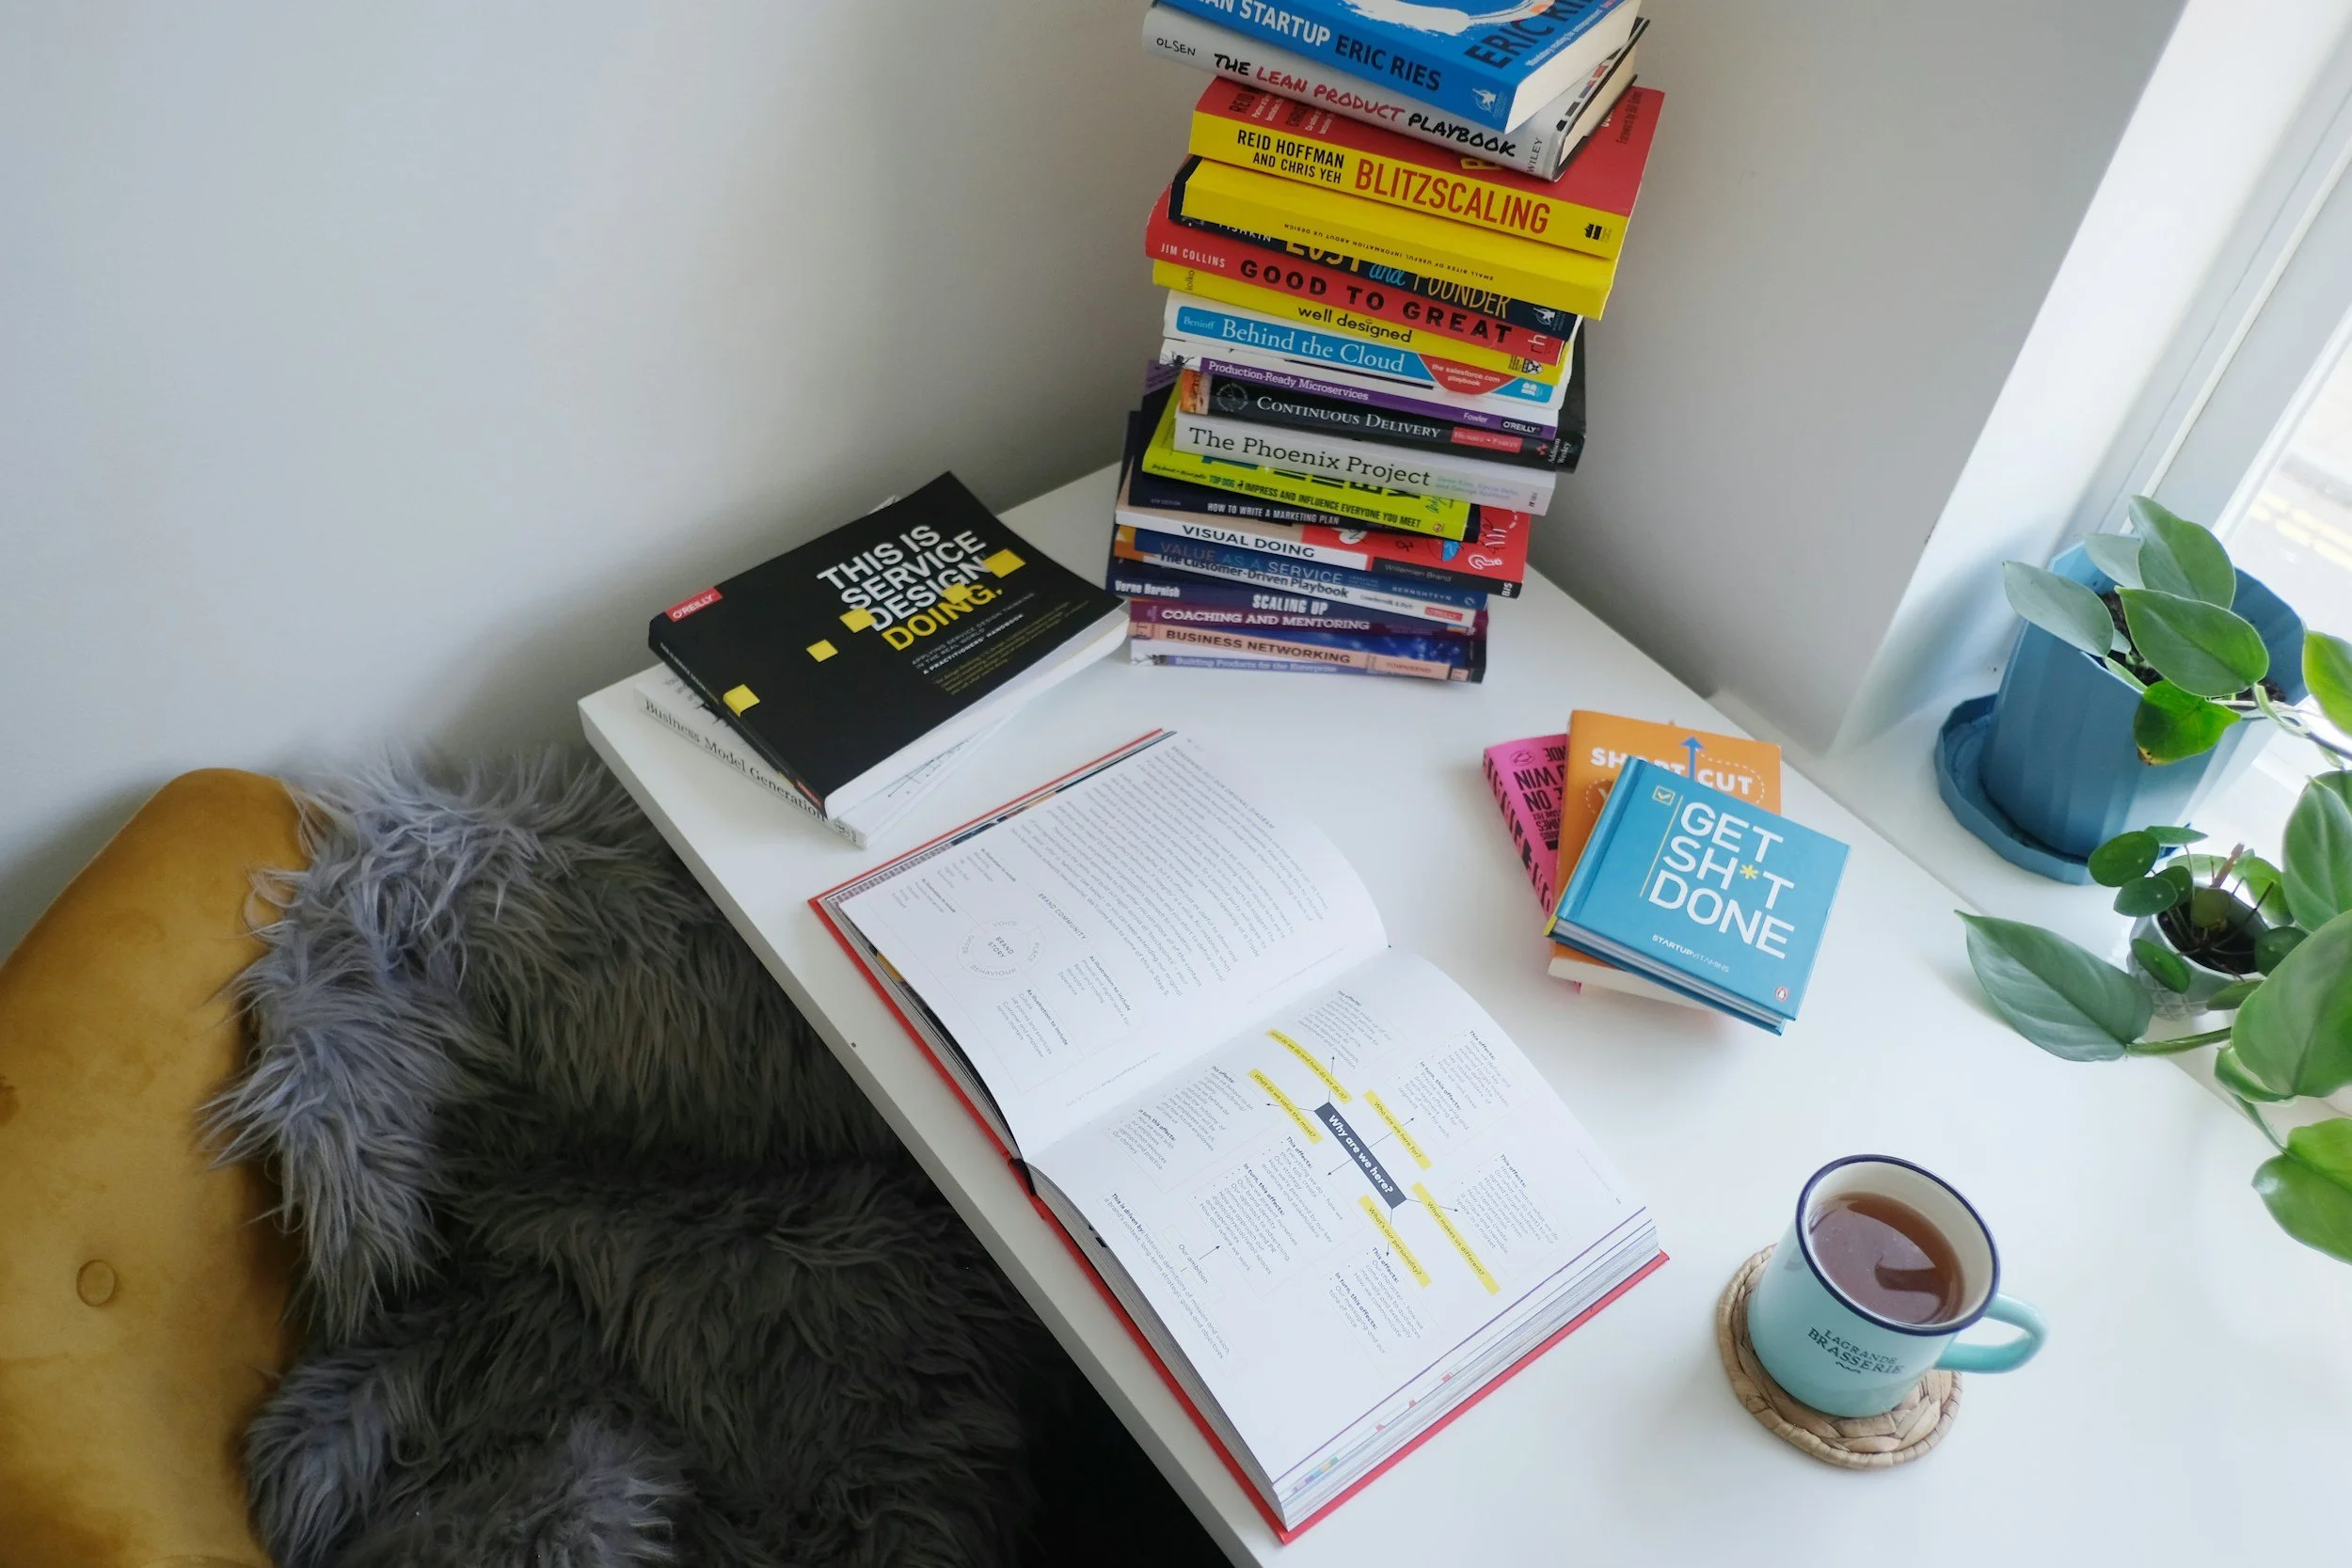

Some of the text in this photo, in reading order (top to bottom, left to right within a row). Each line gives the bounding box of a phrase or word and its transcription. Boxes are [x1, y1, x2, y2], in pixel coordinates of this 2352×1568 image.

[1239, 0, 1441, 91] STARTUP ERIC RIES
[1464, 19, 1554, 69] ERIC
[1156, 38, 1196, 56] OLSEN
[1215, 53, 1251, 75] THE
[1257, 67, 1308, 93] LEAN
[1313, 84, 1406, 122] PRODUCT
[1407, 113, 1517, 158] PLAYBOOK
[1526, 137, 1544, 173] WILEY
[1238, 130, 1344, 168] REID HOFFMAN
[1253, 152, 1342, 184] AND CHRIS YEH
[1355, 158, 1550, 234] BLITZSCALING
[1284, 224, 1311, 235] DESIGN
[1326, 235, 1350, 245] ABOUT
[1161, 243, 1226, 269] JIM COLLINS
[1352, 241, 1406, 259] INFORMATION
[1407, 254, 1432, 265] USEFUL
[1446, 264, 1469, 275] BITES
[1470, 271, 1494, 281] SMALL
[1240, 260, 1513, 344] GOOD TO GREAT
[1183, 316, 1216, 331] Benioff
[1298, 306, 1413, 343] well designed
[1222, 318, 1406, 372] Behind the Cloud
[1208, 360, 1370, 402] Production-Ready Microservices
[1432, 363, 1502, 384] the salesforce.com
[1447, 374, 1481, 388] playbook
[1257, 397, 1359, 425] CONTINUOUS
[1366, 414, 1441, 438] DELIVERY
[1463, 412, 1488, 423] Fowler
[1189, 427, 1430, 487] The Phoenix Project
[1208, 502, 1340, 525] HOW TO WRITE A MARKETING PLAN
[1245, 483, 1279, 498] IMPRESS
[1279, 490, 1296, 501] AND
[1298, 493, 1340, 512] INFLUENCE
[1342, 501, 1381, 519] EVERYONE
[1383, 512, 1398, 523] YOU
[1400, 515, 1421, 529] MEET
[816, 525, 941, 591] THIS IS
[1182, 525, 1315, 558] VISUAL DOING
[841, 531, 987, 610] SERVICE
[1160, 542, 1217, 562] VALUE
[1223, 554, 1244, 566] AS
[1251, 559, 1262, 570] A
[1267, 561, 1343, 585] SERVICE
[1160, 555, 1182, 565] The
[1184, 557, 1289, 587] Customer-Driven
[1290, 578, 1349, 598] Playbook
[1426, 571, 1453, 582] Brand
[672, 594, 715, 619] O'REILLY
[867, 556, 992, 632] DESIGN
[1114, 580, 1181, 598] Verne Harnish
[1253, 594, 1328, 616] SCALING UP
[1502, 581, 1513, 598] BIS
[882, 584, 1003, 651] DOING.
[1161, 610, 1370, 630] COACHING AND MENTORING
[1167, 630, 1351, 664] BUSINESS NETWORKING
[645, 700, 701, 744] Business
[704, 736, 747, 773] Model
[750, 766, 828, 823] Generation
[1680, 801, 1785, 863] GET
[1648, 868, 1796, 960] DONE
[1266, 1085, 1275, 1095] do
[1273, 1093, 1281, 1102] we
[1279, 1101, 1295, 1116] value
[1293, 1112, 1302, 1121] the
[1300, 1120, 1317, 1138] most?
[1374, 1101, 1422, 1159] Who are we here for?
[1285, 1136, 1312, 1169] This affects:
[1328, 1115, 1394, 1194] Why are we here?
[1384, 1228, 1394, 1240] our
[1391, 1239, 1422, 1276] personality?
[1427, 1202, 1486, 1276] What makes us different?
[1371, 1246, 1400, 1282] This affects:
[1807, 1326, 1904, 1374] BRASSERIE
[1825, 1330, 1899, 1364] LAGRANDE
